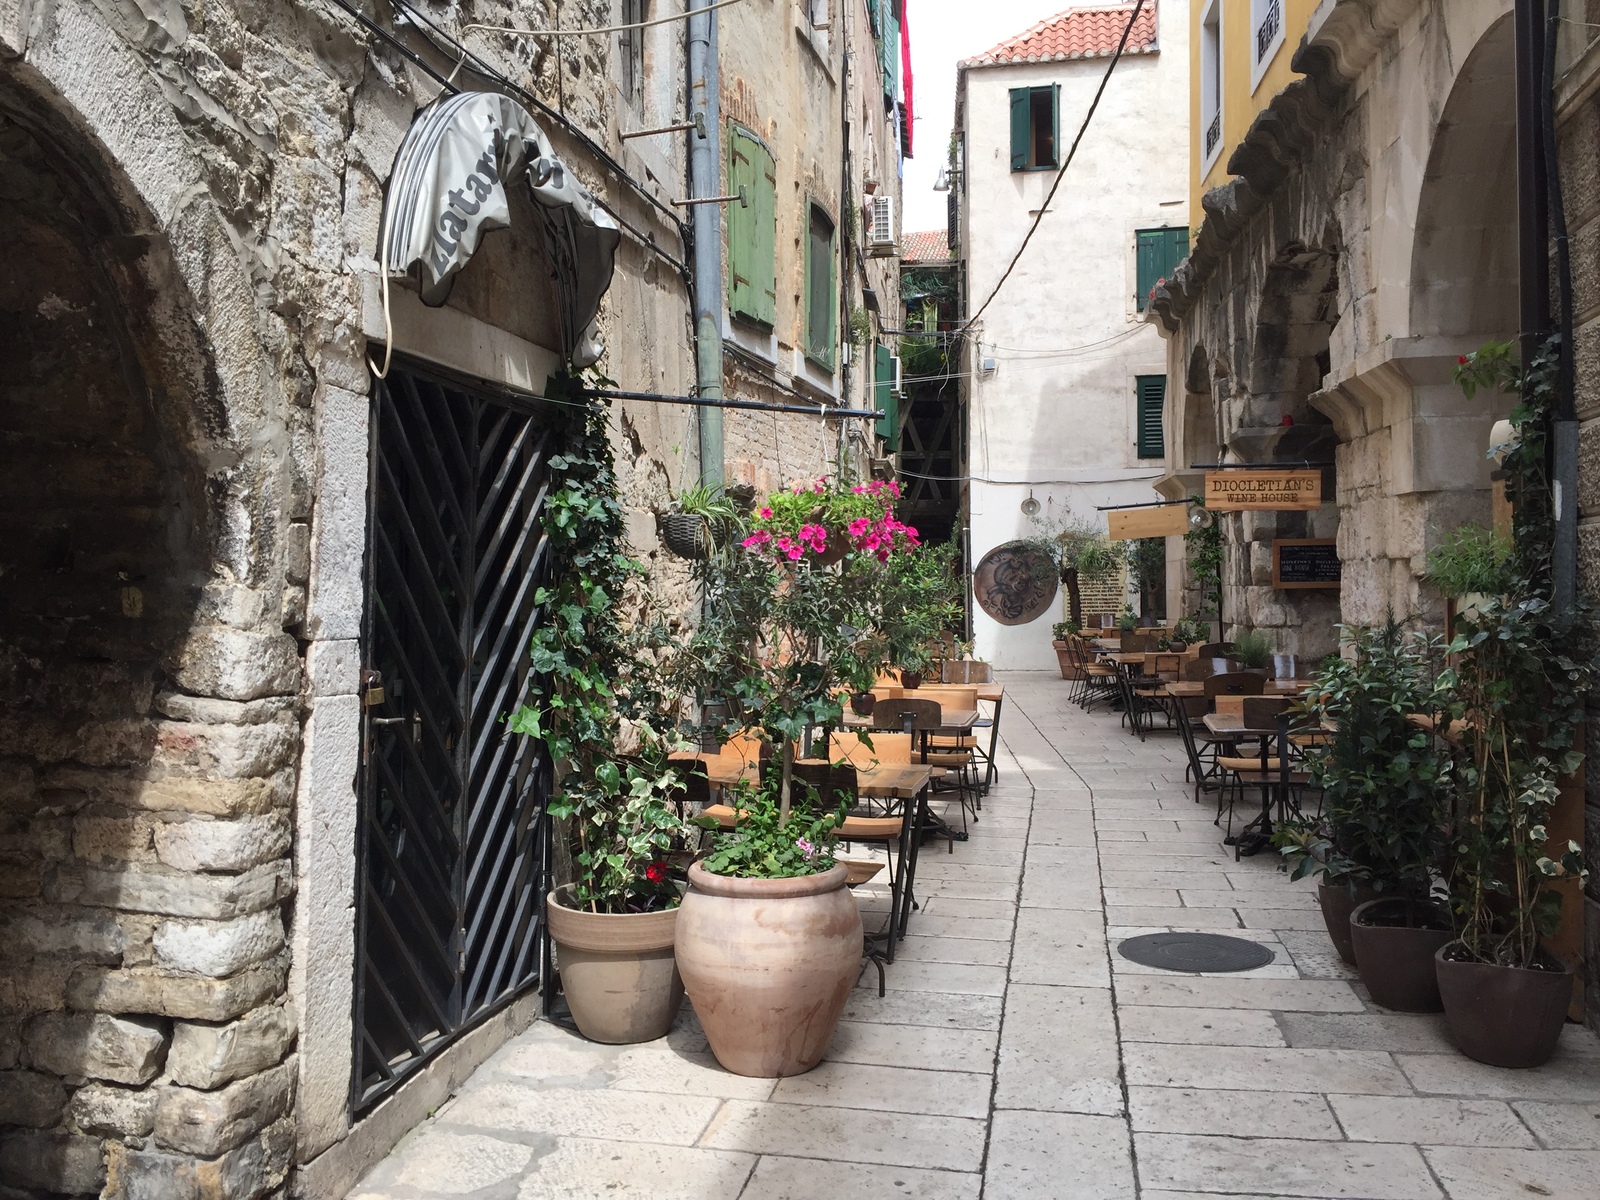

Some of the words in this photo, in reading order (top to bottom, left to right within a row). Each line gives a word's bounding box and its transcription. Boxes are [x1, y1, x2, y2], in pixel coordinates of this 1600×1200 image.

[1212, 478, 1315, 492] DIOCLETIAN'S
[1226, 493, 1257, 503] WINE
[1260, 493, 1299, 503] HOUSE
